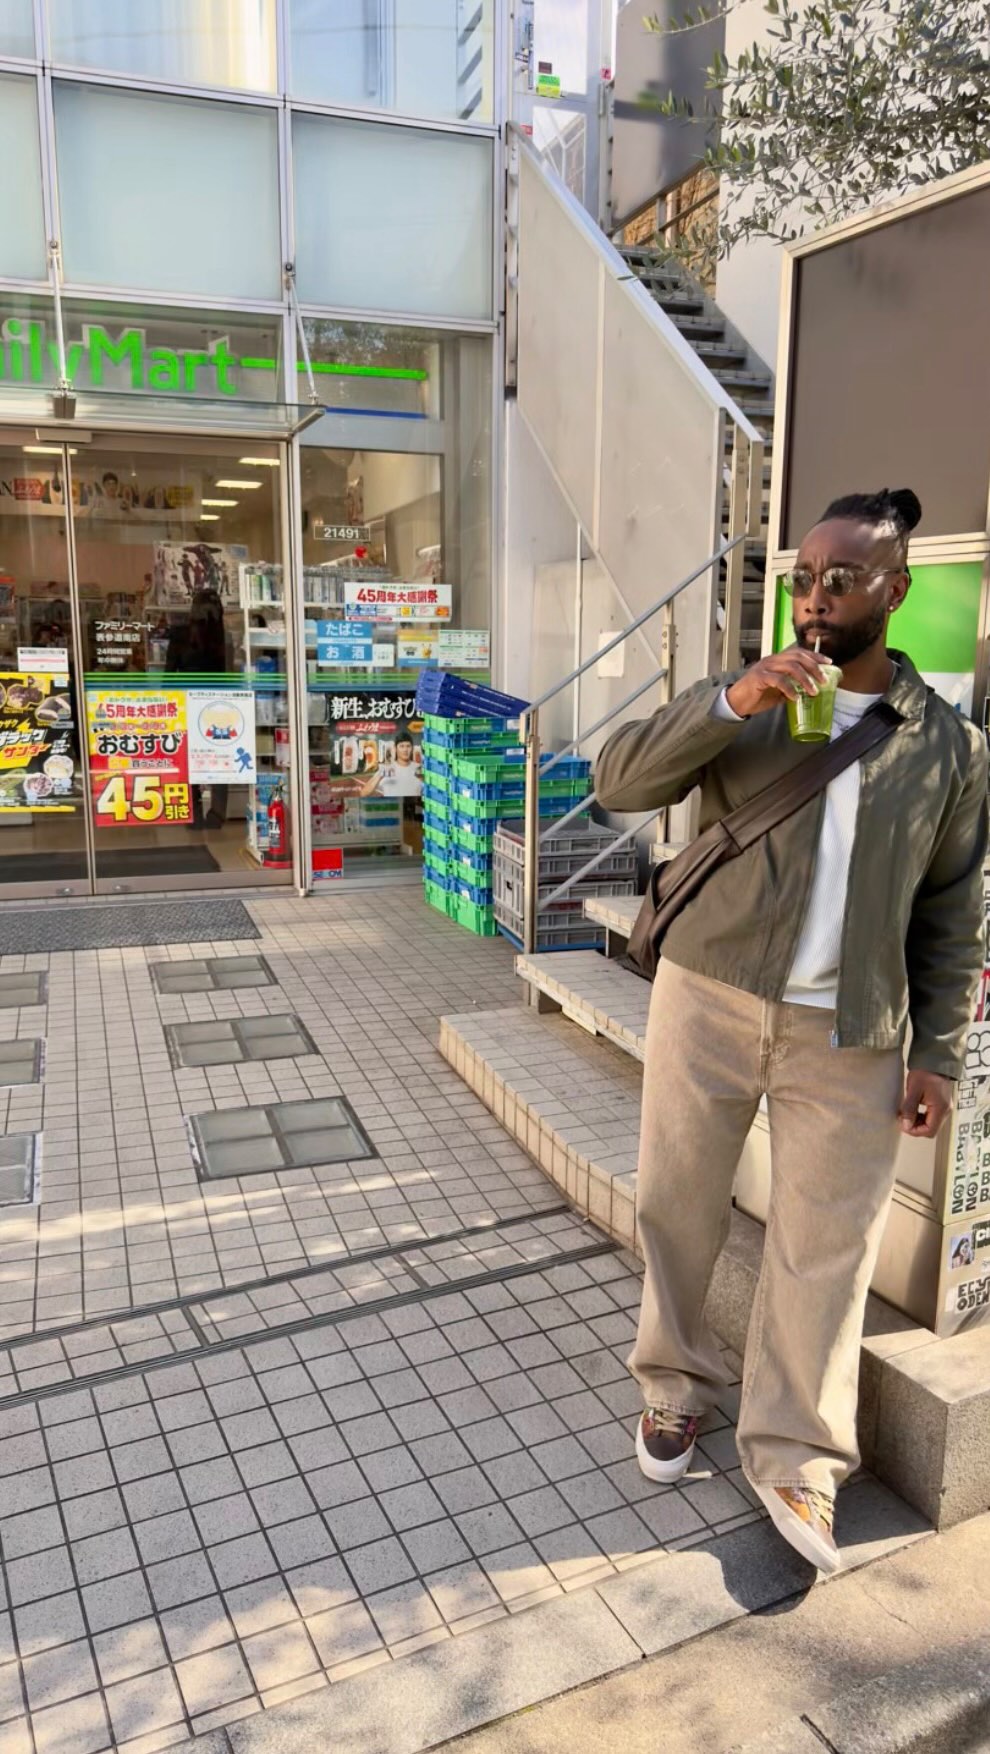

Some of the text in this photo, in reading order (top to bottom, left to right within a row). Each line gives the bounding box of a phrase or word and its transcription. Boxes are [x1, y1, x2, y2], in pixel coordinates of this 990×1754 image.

[0, 318, 237, 396] ilyMart
[323, 527, 360, 540] 21491
[357, 588, 438, 604] 45周年大感謝祭
[95, 620, 156, 632] ファミリーマート
[325, 622, 364, 637] たばこ
[98, 731, 181, 755] おむすび
[97, 775, 164, 821] 45
